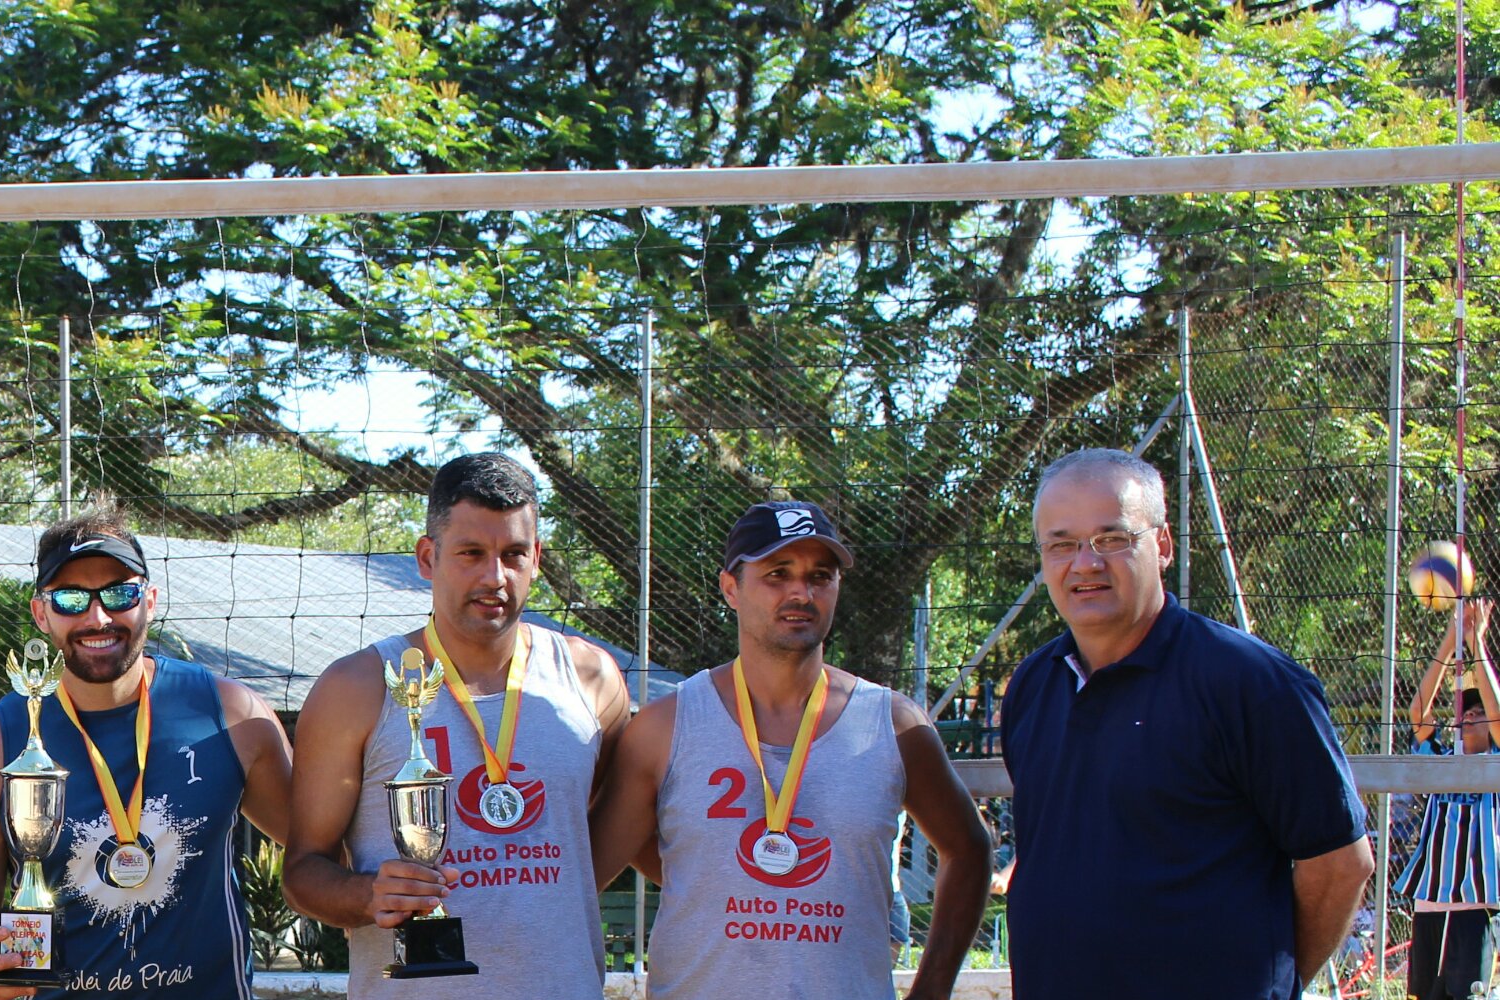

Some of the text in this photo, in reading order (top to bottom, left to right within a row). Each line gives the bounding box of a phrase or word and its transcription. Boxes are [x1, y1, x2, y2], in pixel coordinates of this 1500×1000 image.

[425, 726, 452, 774] 1
[186, 750, 202, 784] 1
[707, 767, 747, 818] 2
[442, 842, 561, 866] Auto Posto
[725, 896, 845, 918] Auto Posto
[724, 921, 843, 943] COMPANY
[108, 968, 133, 991] de
[139, 963, 194, 989] Praia
